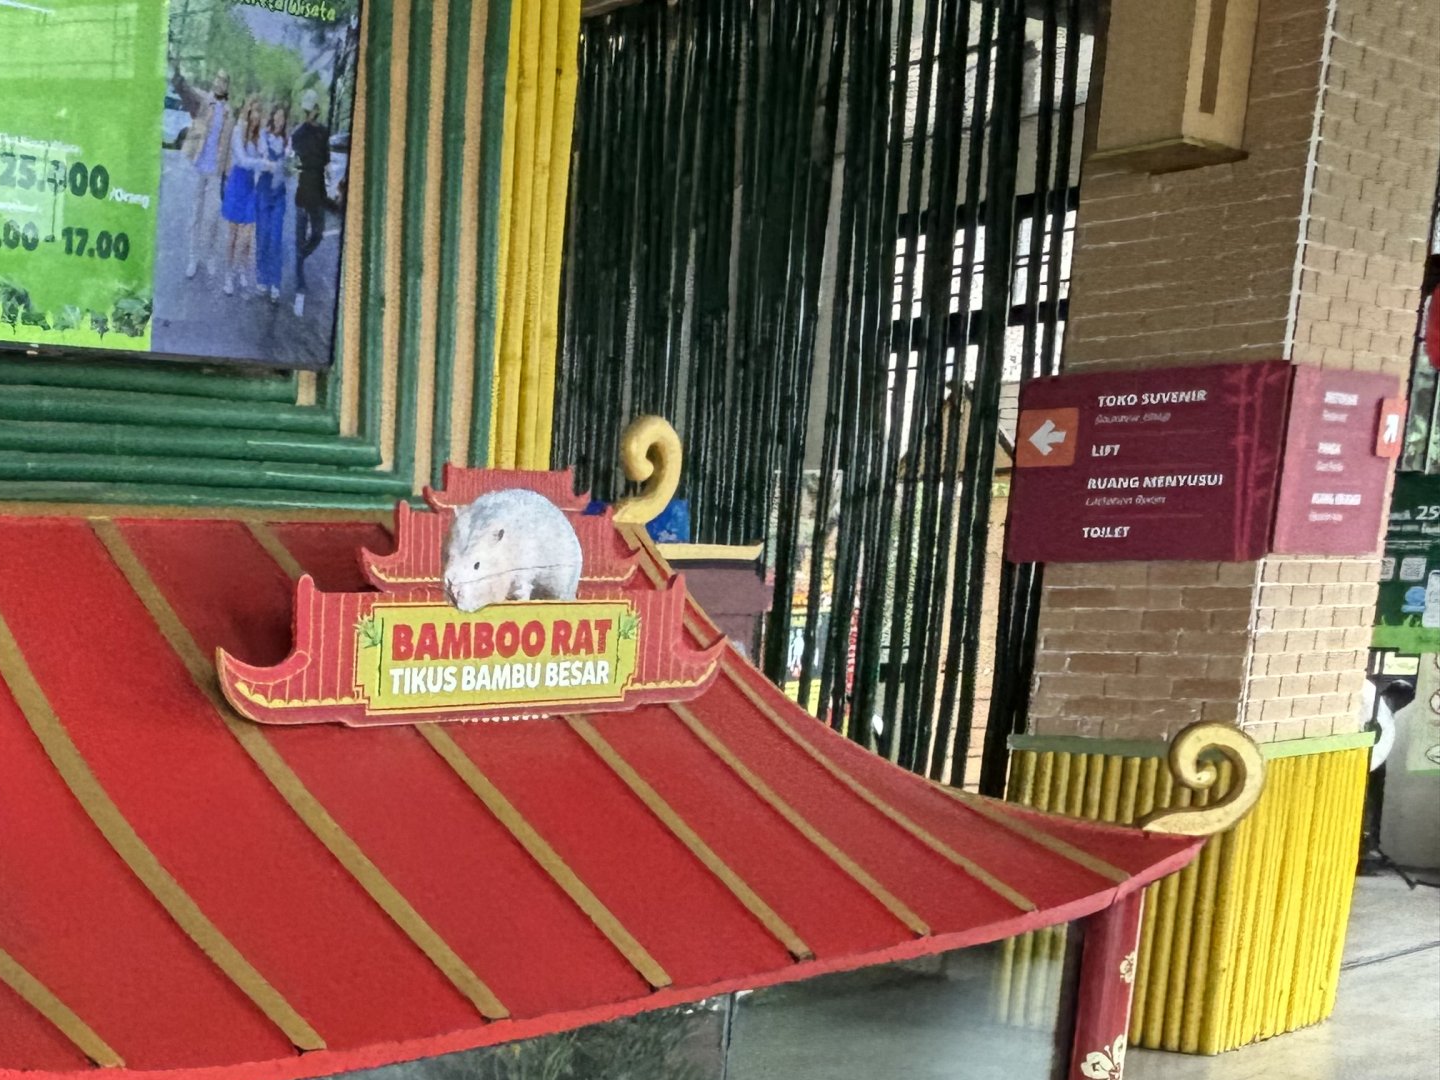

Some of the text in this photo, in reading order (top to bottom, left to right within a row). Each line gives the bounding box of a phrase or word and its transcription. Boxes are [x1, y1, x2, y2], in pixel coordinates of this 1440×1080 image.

[288, 0, 336, 21] Wisata
[62, 226, 131, 261] 17.00
[1098, 390, 1208, 407] TOKO SUVENIR
[1091, 444, 1120, 457] LIFT
[1087, 474, 1224, 490] RUANG MENYUSUI
[1082, 526, 1130, 539] TOILET
[391, 618, 612, 661] BAMBOO RAT
[389, 659, 610, 695] TIKUS BAMBU BESAR
